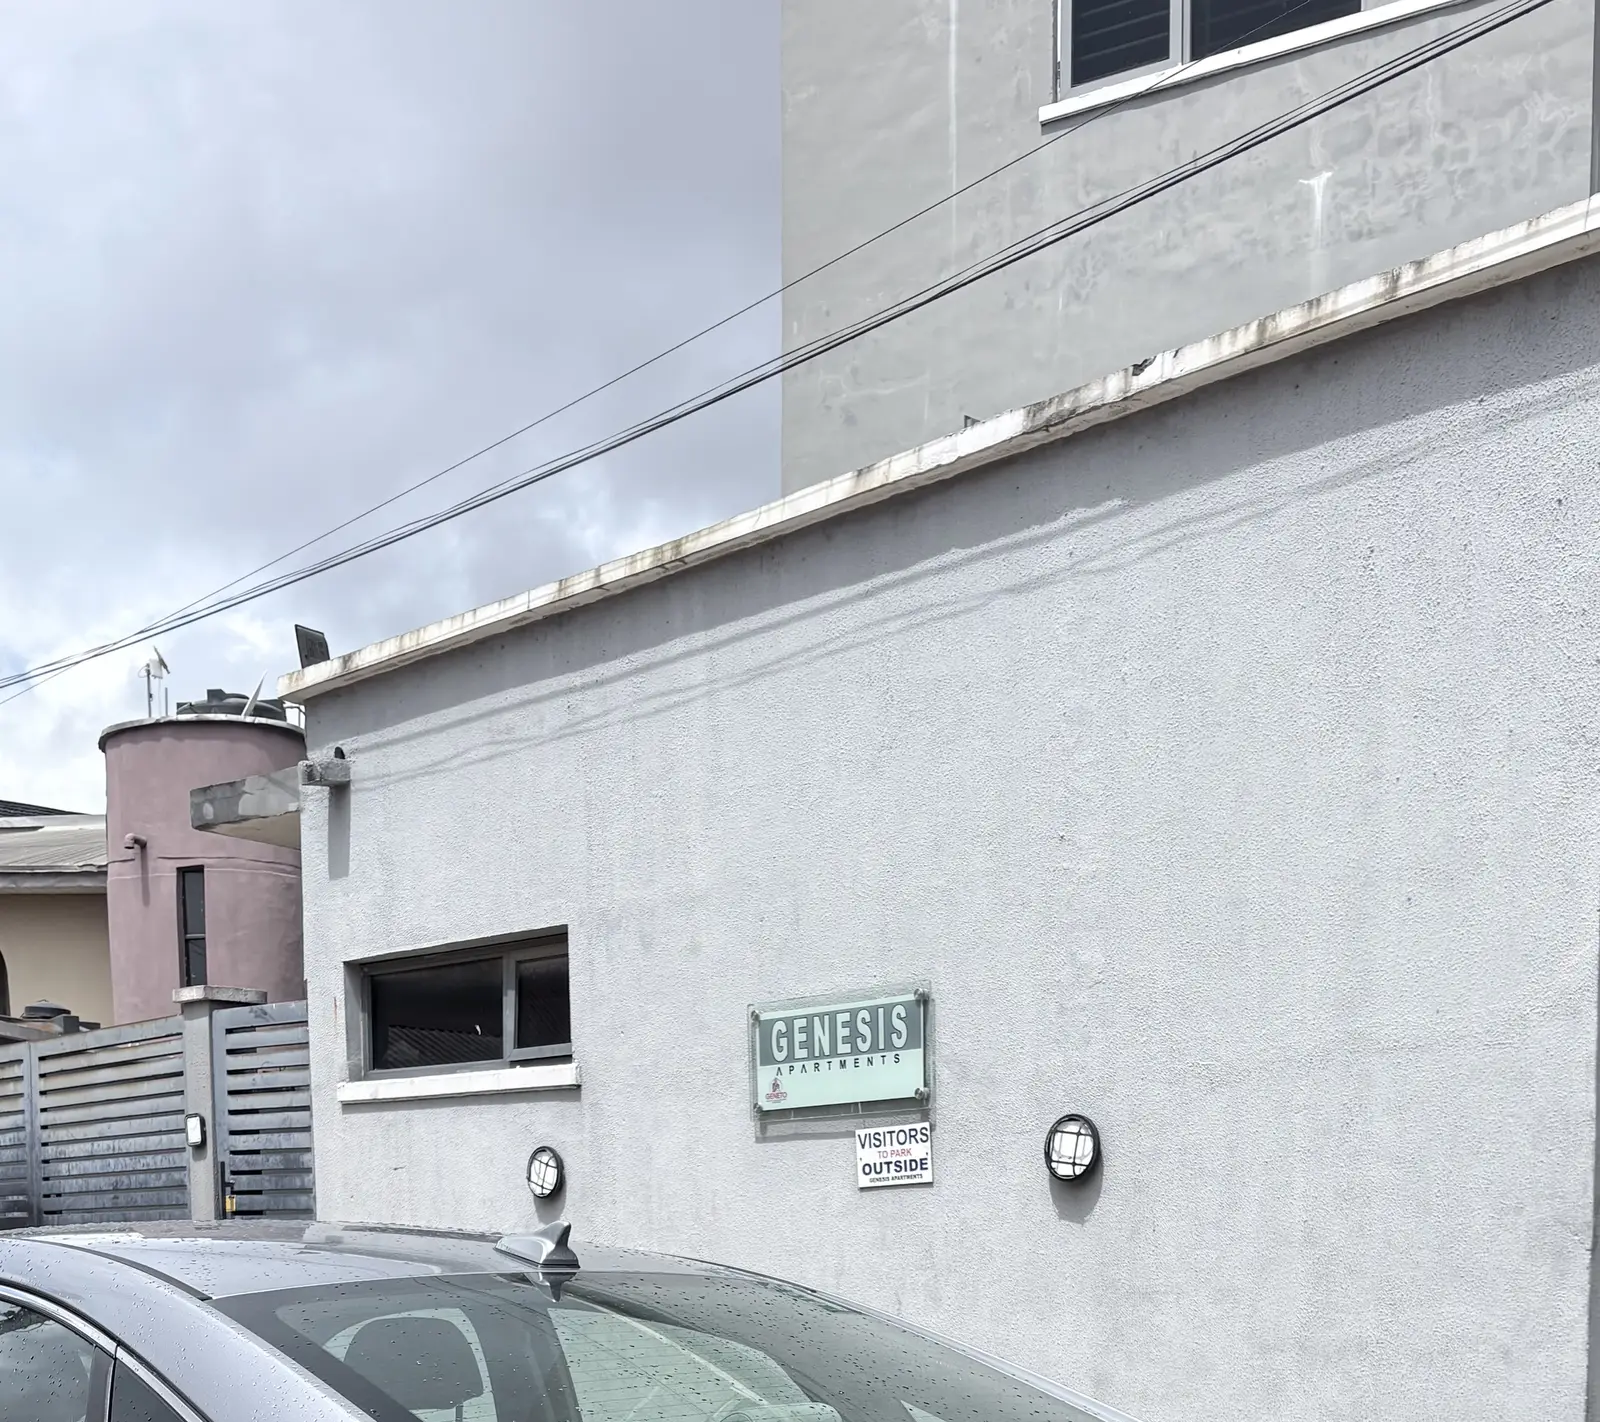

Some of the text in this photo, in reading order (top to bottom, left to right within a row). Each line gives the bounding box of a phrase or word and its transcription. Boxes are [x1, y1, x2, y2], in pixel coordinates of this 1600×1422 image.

[771, 1004, 908, 1062] GENESIS
[776, 1053, 901, 1076] APARTMENTS
[857, 1126, 930, 1149] VISITORS
[877, 1147, 912, 1159] TO PARK
[862, 1157, 929, 1176] OUTSIDE
